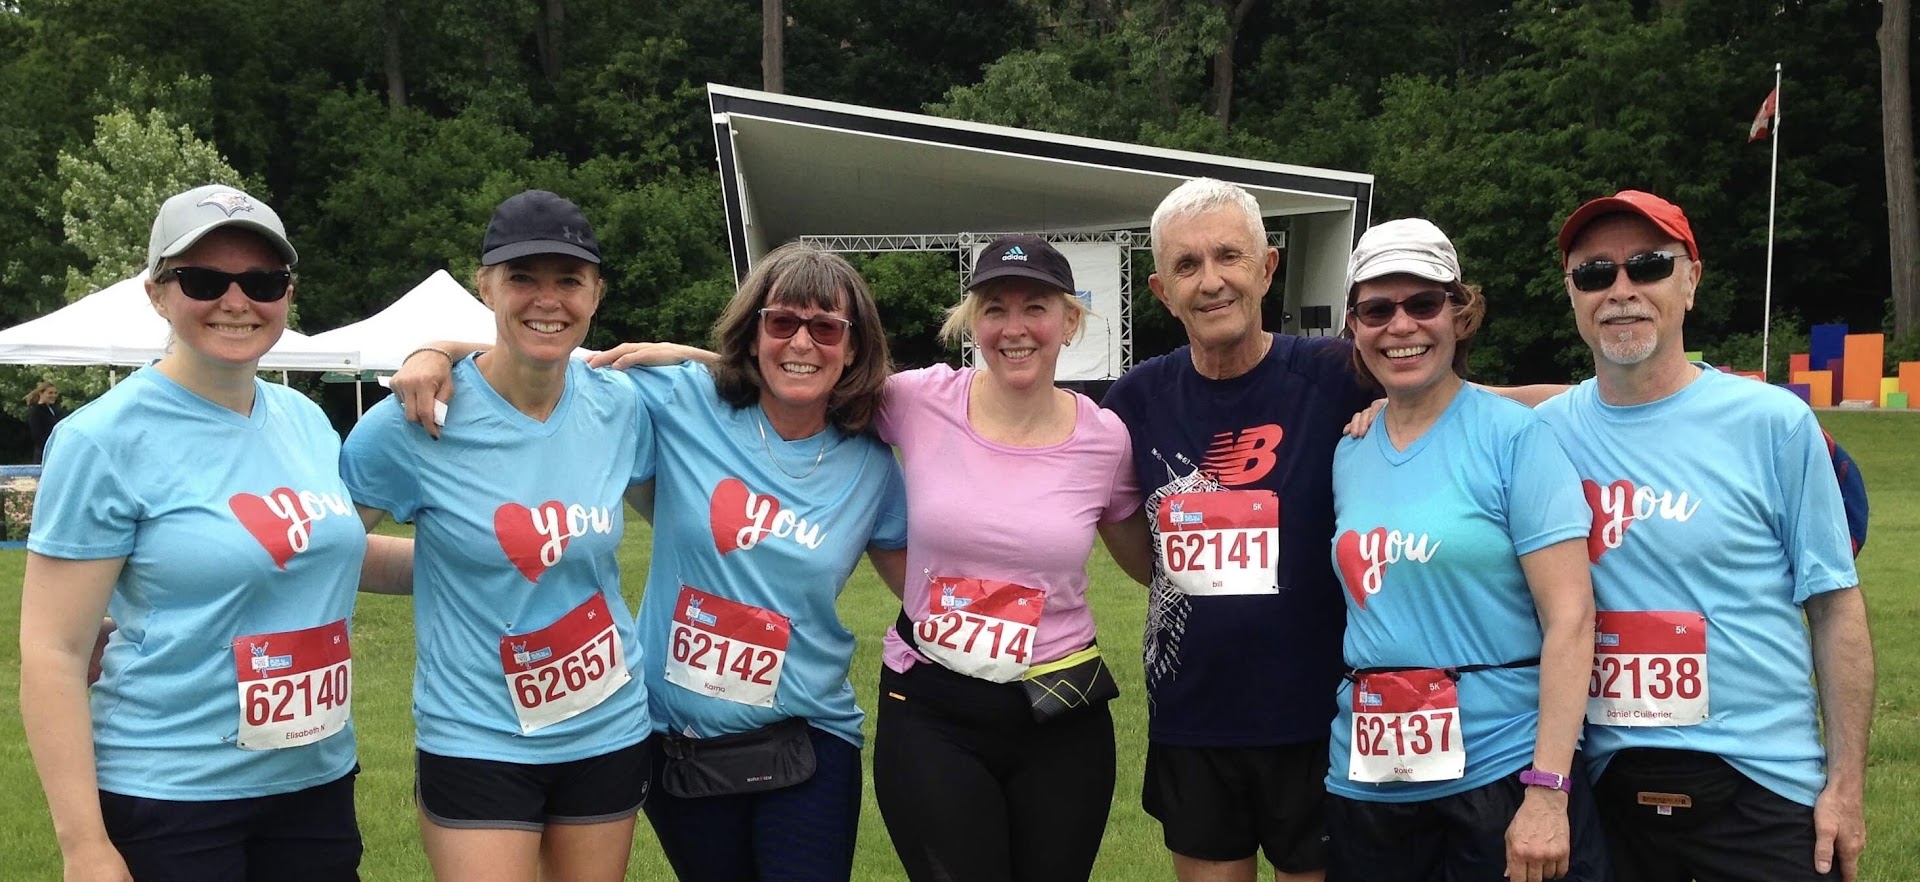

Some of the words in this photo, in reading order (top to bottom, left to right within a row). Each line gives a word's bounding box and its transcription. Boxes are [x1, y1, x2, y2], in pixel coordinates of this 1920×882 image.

[261, 489, 353, 553] you
[736, 491, 828, 550] you
[1252, 502, 1263, 511] 5K
[1601, 485, 1703, 549] you
[530, 503, 616, 567] you
[1166, 530, 1268, 572] 62141
[1359, 529, 1443, 595] you
[1018, 598, 1028, 606] 5K
[1212, 580, 1223, 588] bill
[587, 608, 597, 620] 5K
[765, 622, 777, 632] 5K
[1675, 625, 1687, 635] 5K
[333, 634, 341, 644] 5K
[672, 626, 778, 686] 62142
[514, 629, 616, 709] 62657
[1429, 682, 1440, 691] 5K
[1588, 656, 1702, 700] 62138
[246, 664, 348, 727] 62140
[1607, 709, 1631, 718] Daniel
[285, 726, 320, 740] Elisabeth
[1356, 711, 1453, 757] 62137
